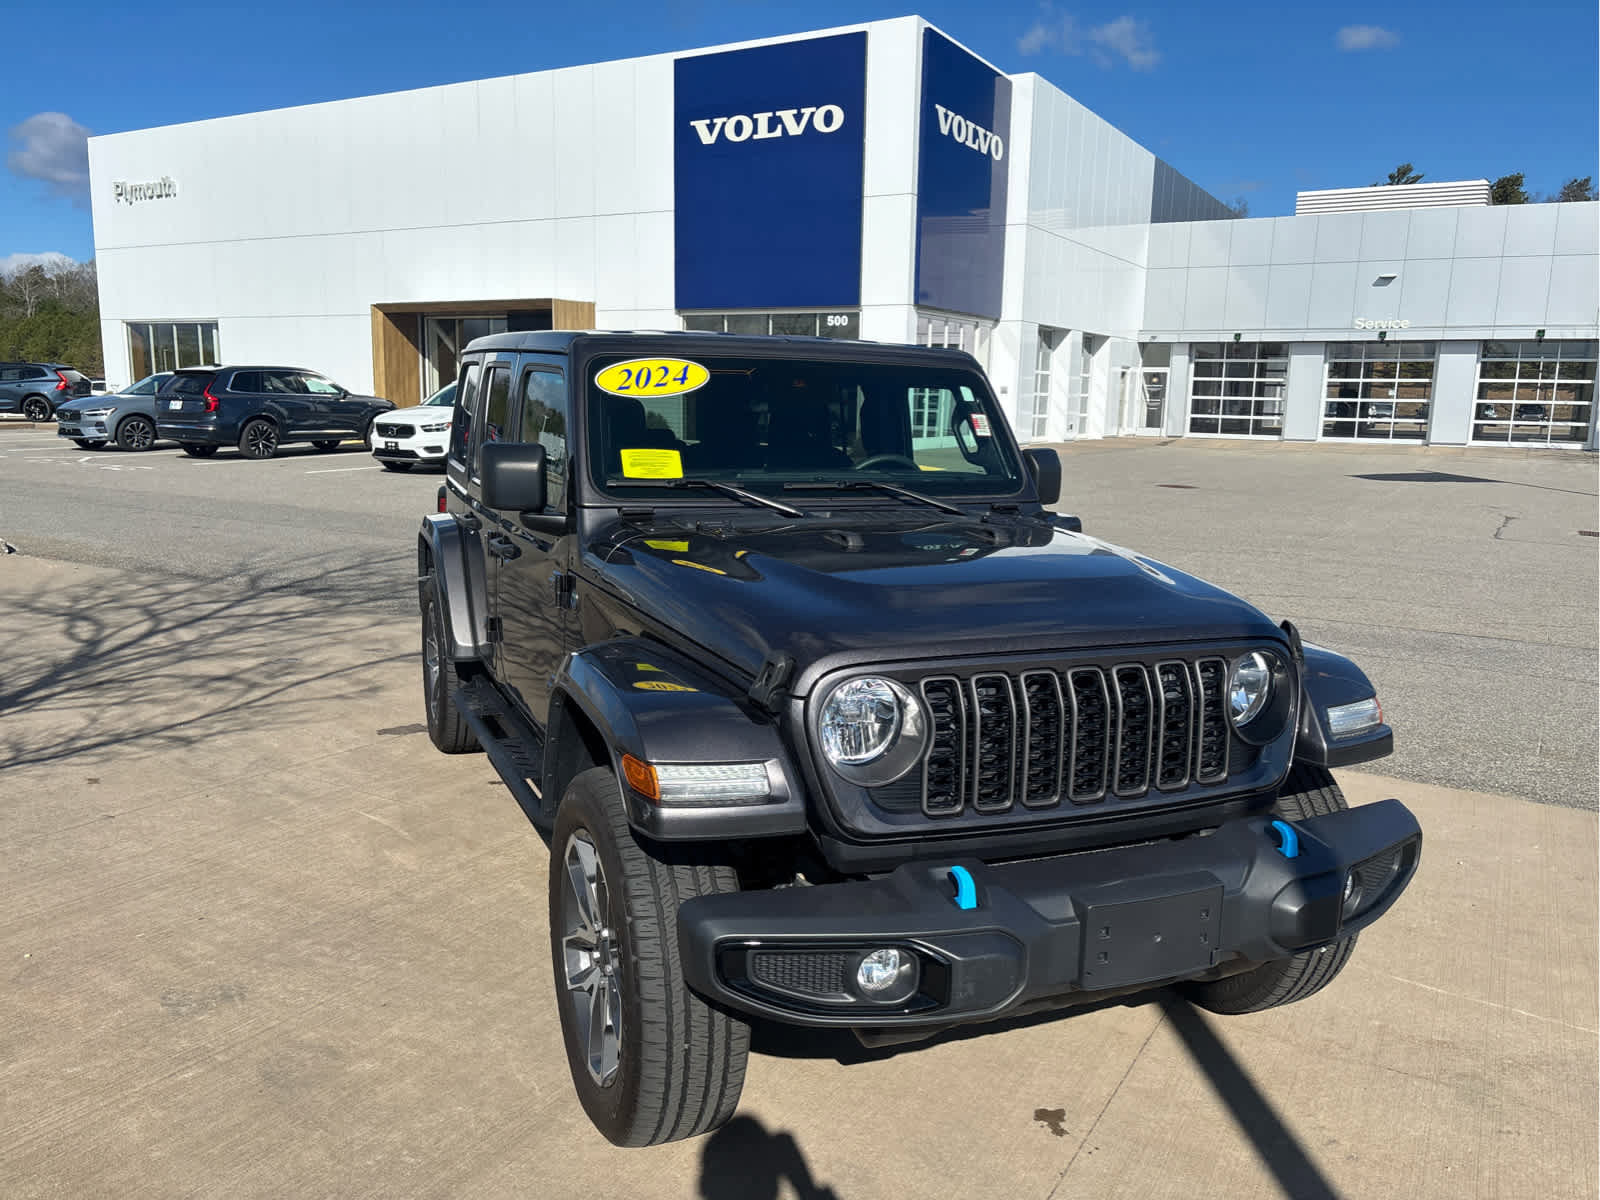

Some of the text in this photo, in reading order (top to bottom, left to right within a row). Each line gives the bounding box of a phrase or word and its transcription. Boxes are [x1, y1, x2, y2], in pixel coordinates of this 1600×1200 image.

[690, 104, 844, 145] VOLVO
[935, 103, 1003, 160] VOLVO
[113, 176, 176, 205] Plymouth
[827, 315, 848, 326] 500
[1354, 318, 1409, 329] Service
[616, 364, 690, 391] 2024
